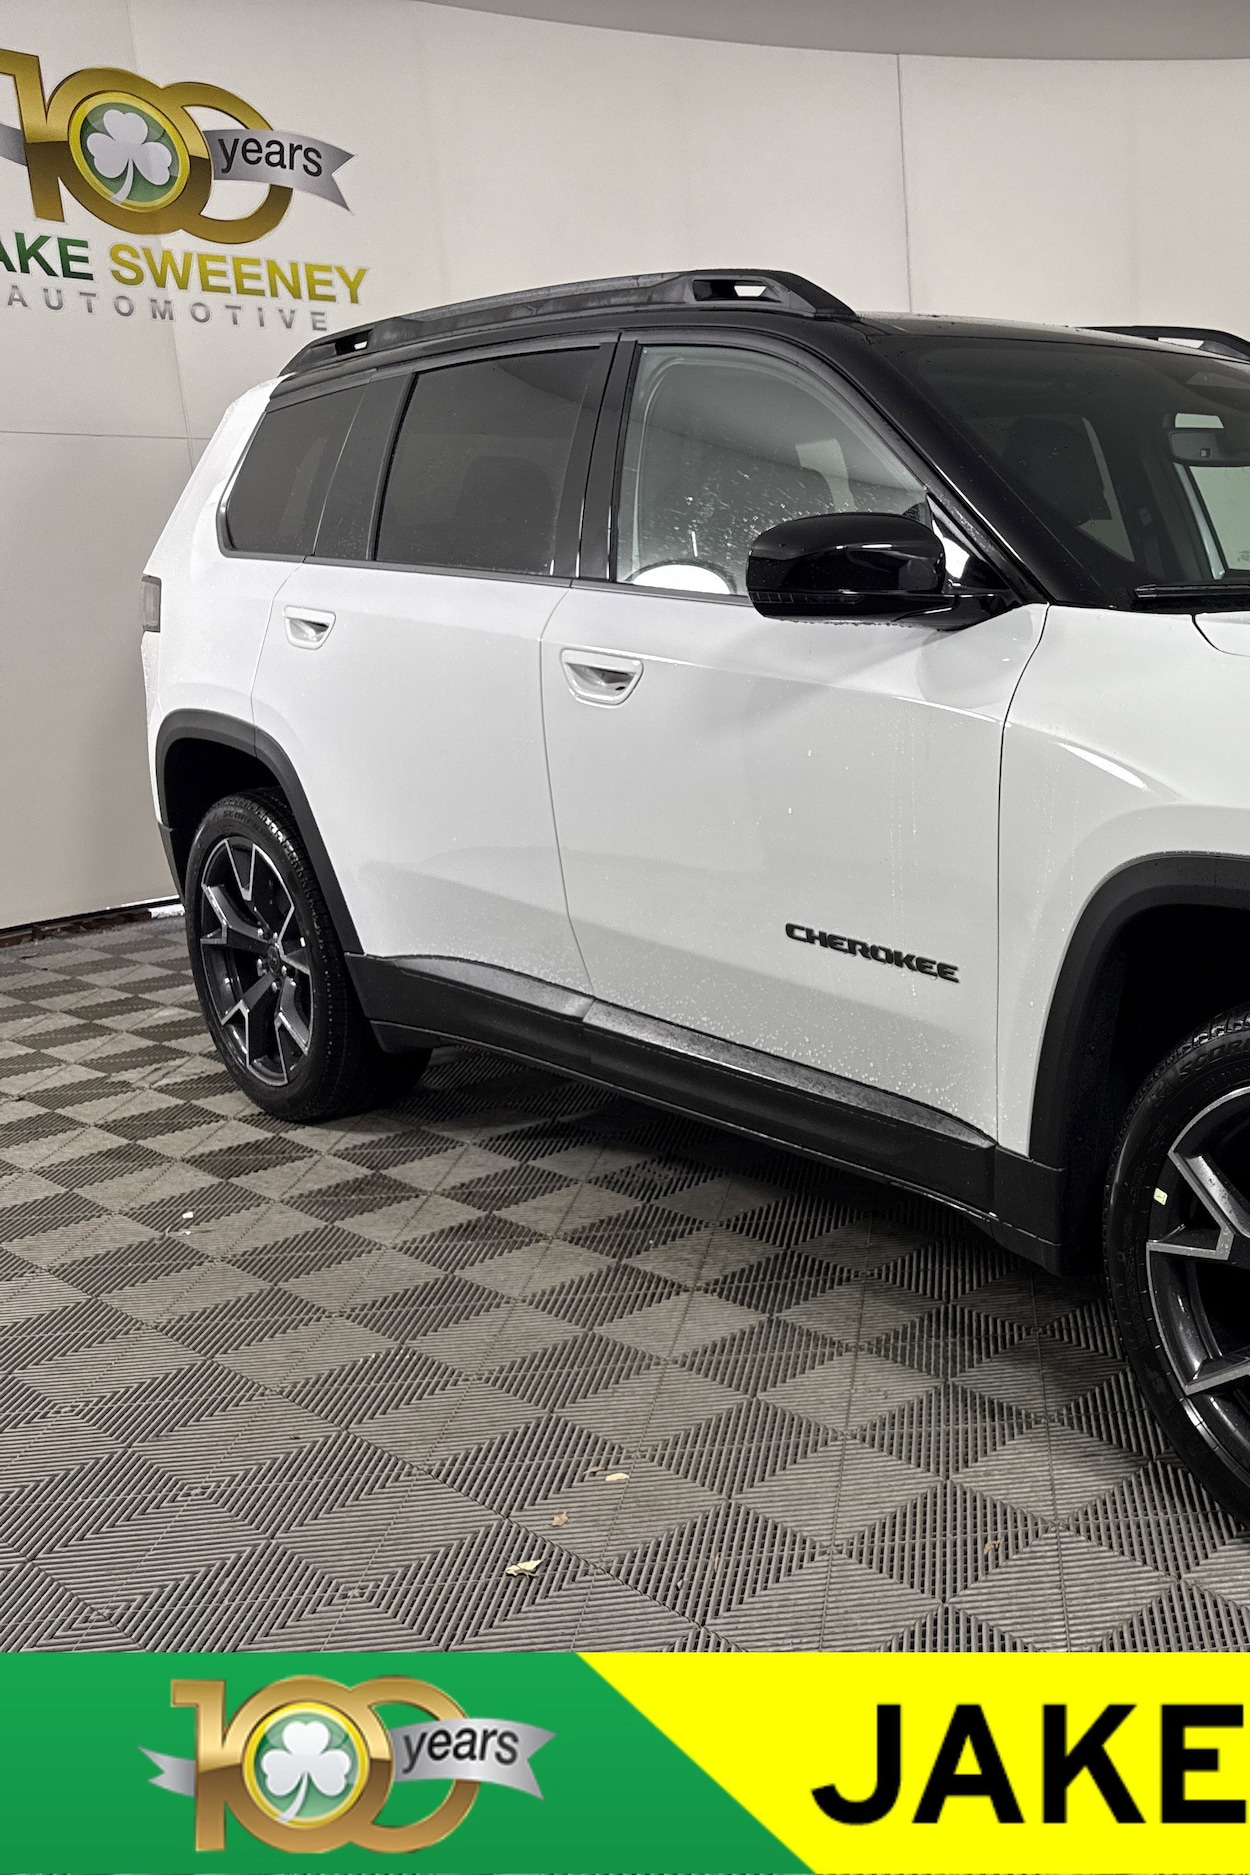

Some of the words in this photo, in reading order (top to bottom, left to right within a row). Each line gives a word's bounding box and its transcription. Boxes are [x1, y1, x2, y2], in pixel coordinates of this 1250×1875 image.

[217, 134, 323, 178] years
[110, 243, 368, 304] SWEENEY
[8, 285, 328, 332] AUTOMOTIVE
[785, 922, 960, 983] CHEROKEE
